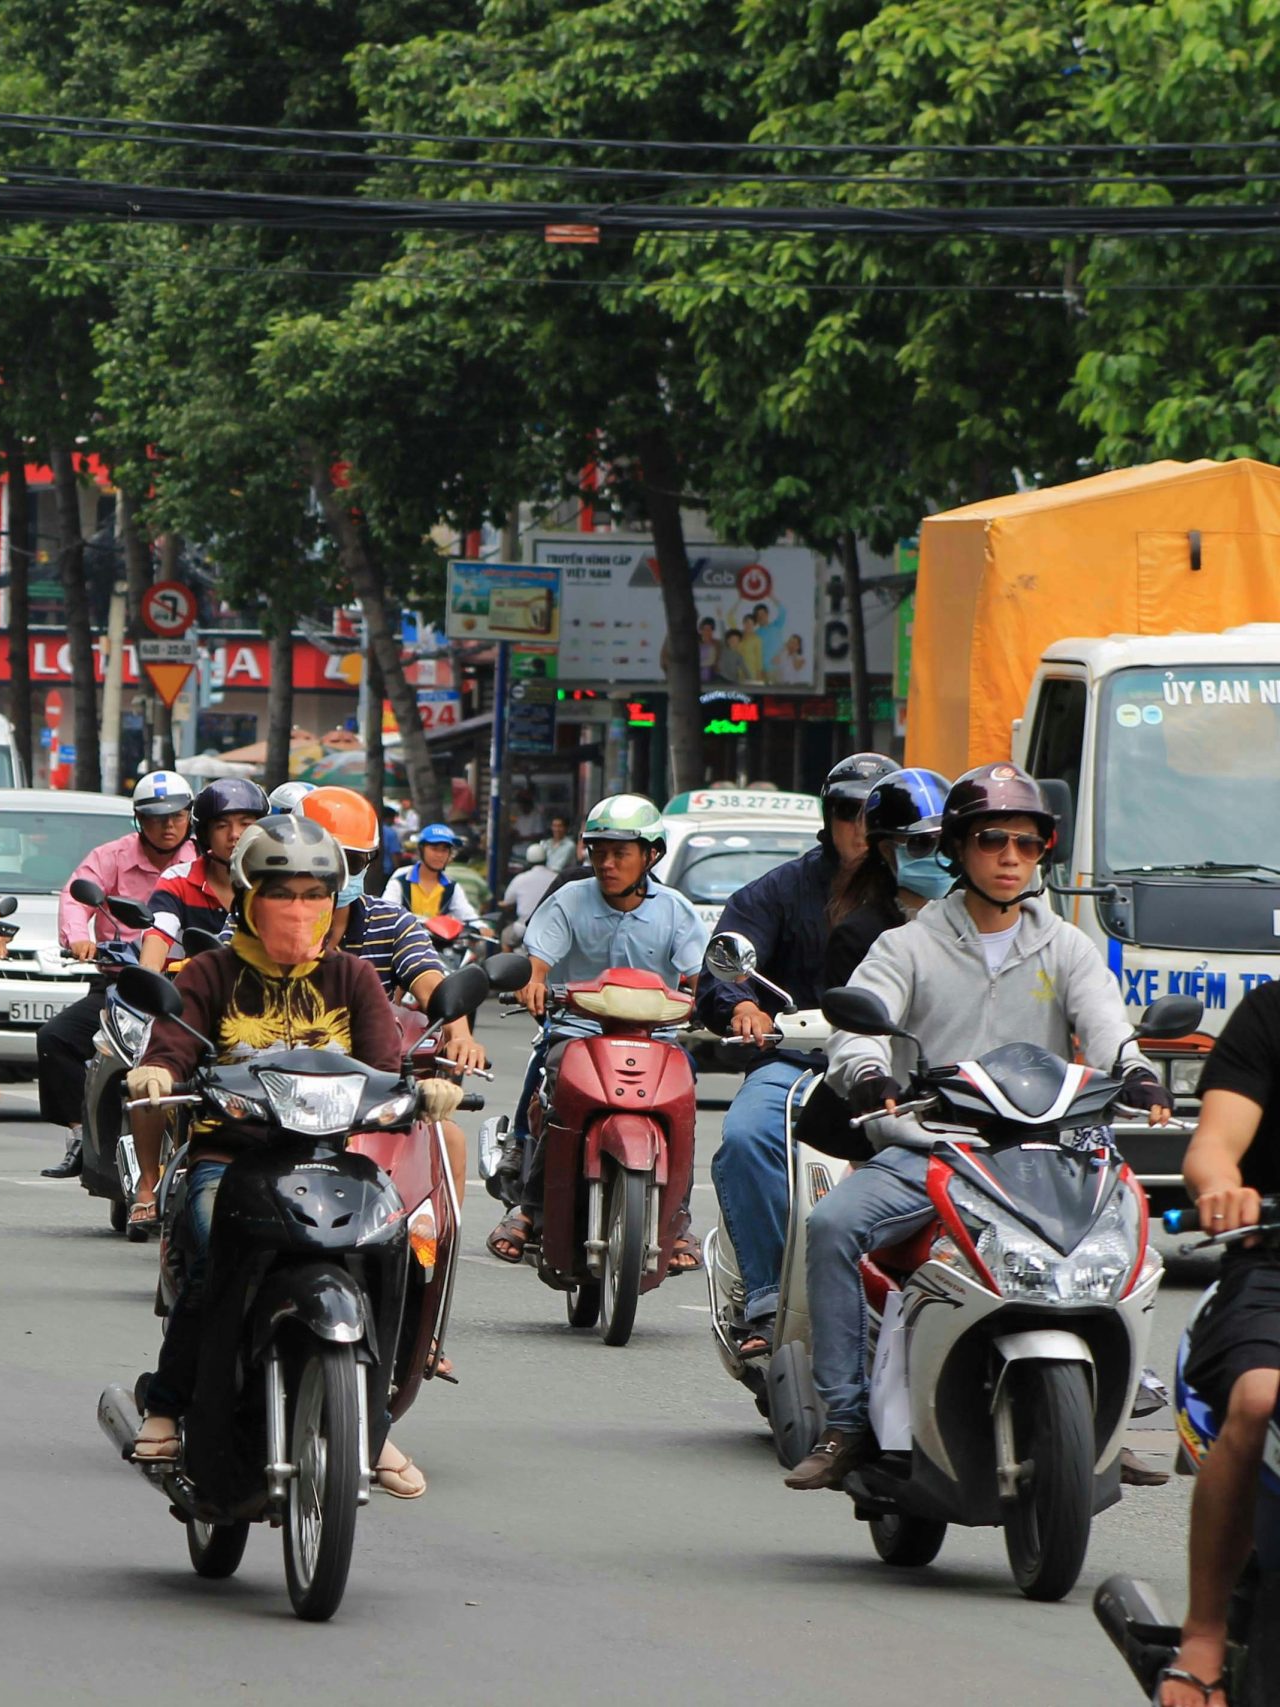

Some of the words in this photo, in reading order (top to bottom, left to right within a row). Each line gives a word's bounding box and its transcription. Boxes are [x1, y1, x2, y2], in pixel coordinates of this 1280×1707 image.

[1162, 671, 1196, 706] ỦY
[1200, 680, 1251, 704] BAN
[419, 705, 455, 728] 24
[721, 795, 766, 809] 38.27
[771, 798, 790, 810] 27
[795, 799, 814, 811] 27
[1124, 969, 1159, 1006] XE
[294, 1163, 340, 1172] HONDA
